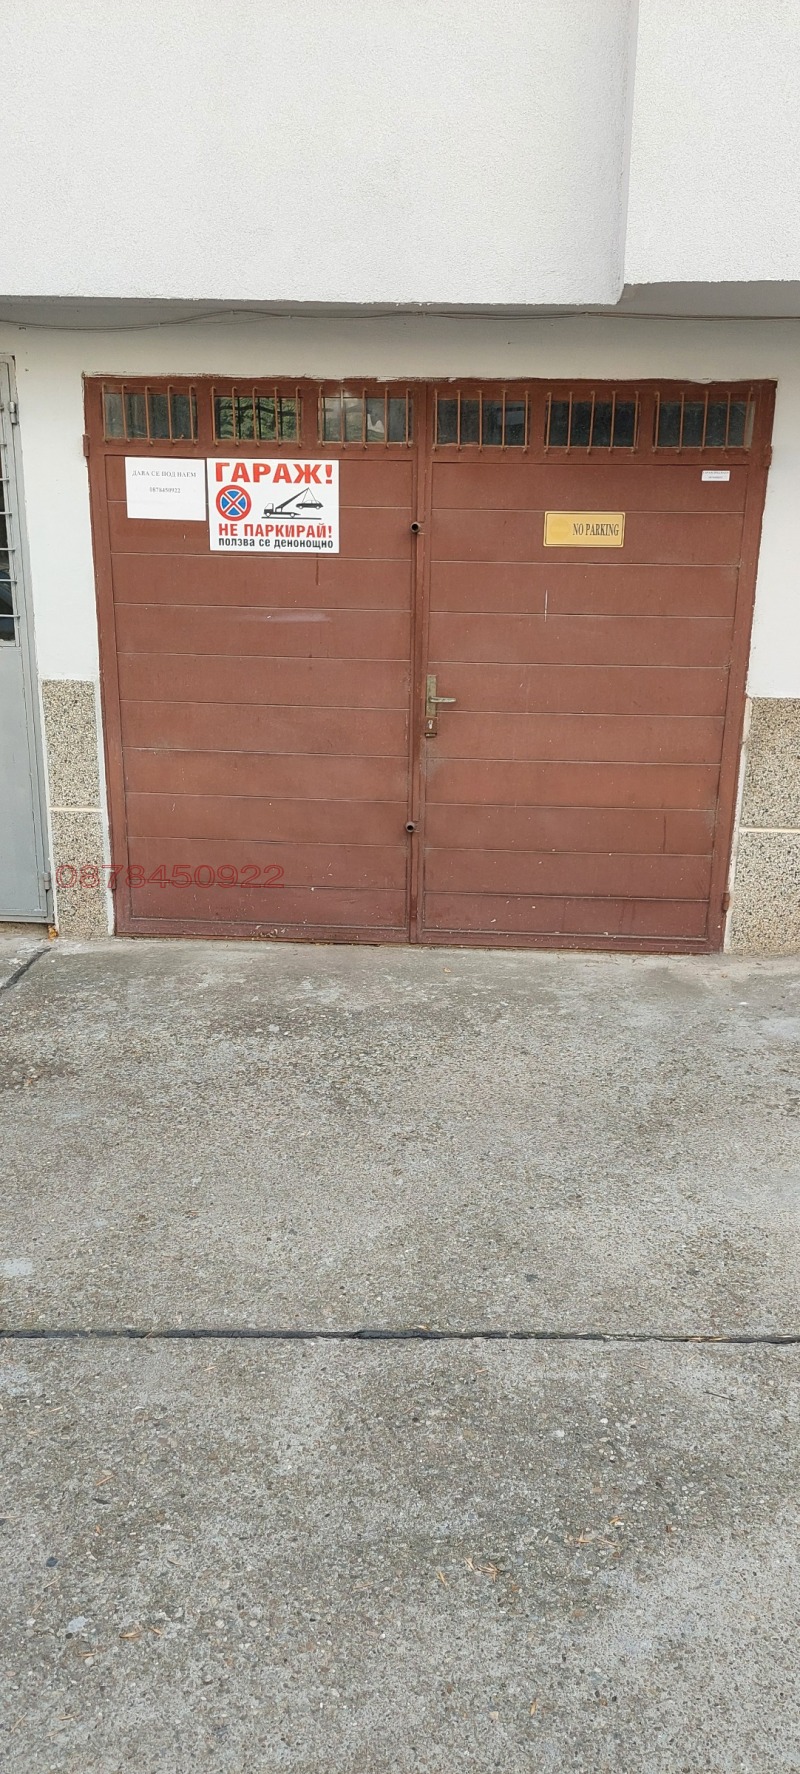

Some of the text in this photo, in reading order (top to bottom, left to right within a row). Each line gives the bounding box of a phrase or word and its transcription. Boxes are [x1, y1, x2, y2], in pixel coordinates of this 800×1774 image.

[215, 462, 333, 484] ГАРАЖ!
[218, 522, 332, 539] НЕ ПАРКИРАЙ!
[573, 523, 620, 537] NO PARKING
[218, 537, 334, 550] ползва се денонощно
